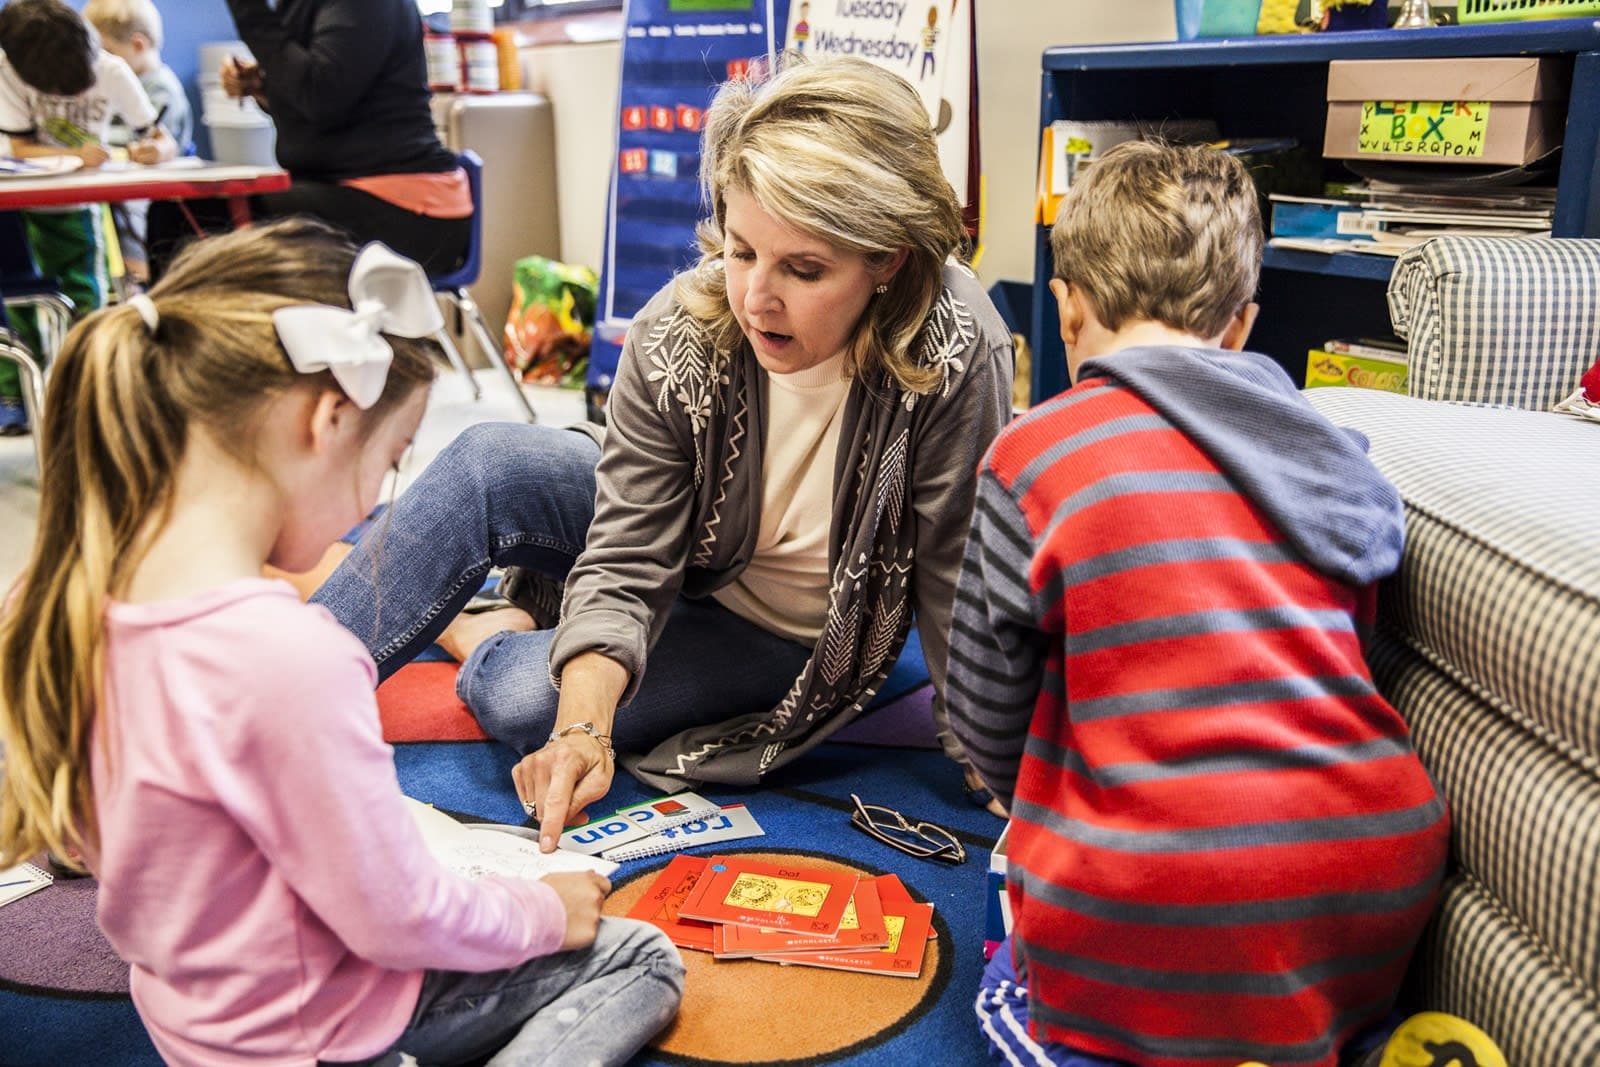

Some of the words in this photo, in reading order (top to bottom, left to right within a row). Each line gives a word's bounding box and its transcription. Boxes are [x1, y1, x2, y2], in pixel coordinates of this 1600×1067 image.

[815, 30, 917, 67] Wednesday
[1390, 115, 1445, 141] BOX
[571, 810, 654, 844] can
